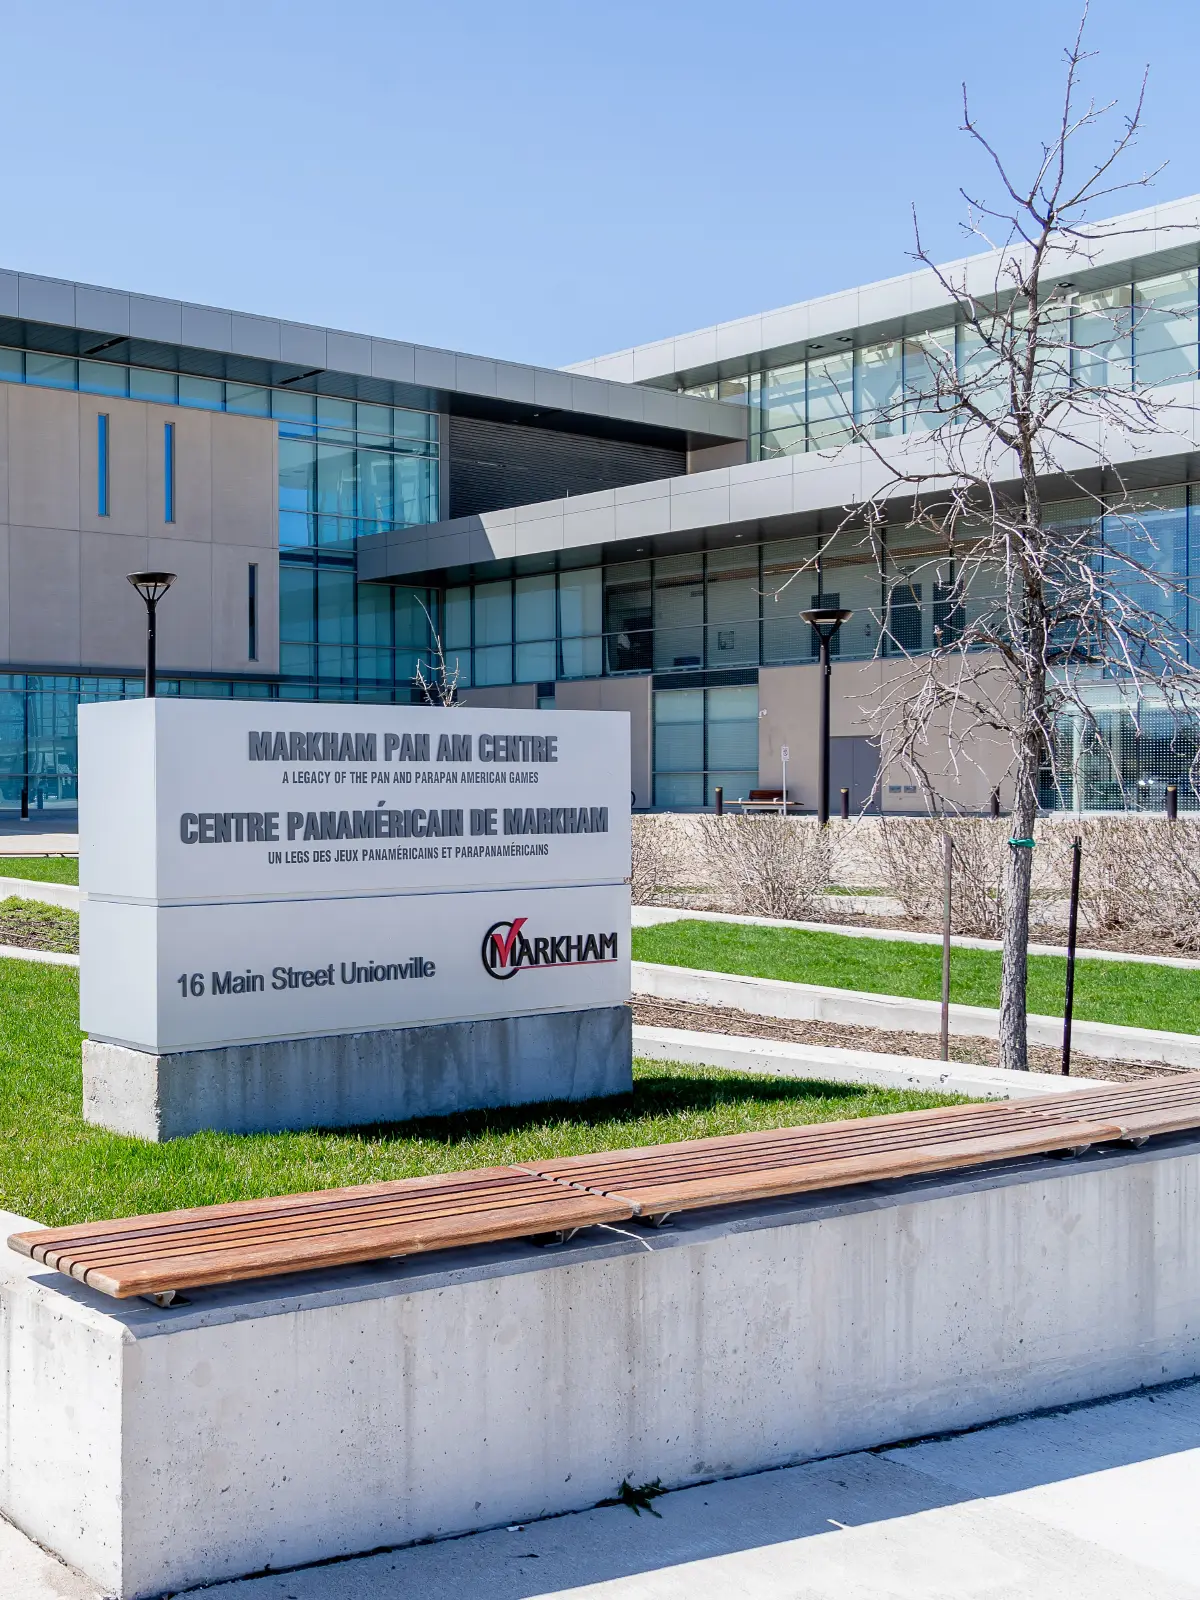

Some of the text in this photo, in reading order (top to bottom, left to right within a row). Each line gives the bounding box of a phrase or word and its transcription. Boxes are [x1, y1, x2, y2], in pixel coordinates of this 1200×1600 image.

[249, 731, 558, 762] MARKHAM PAN AM CENTRE
[282, 771, 539, 784] A LEGACY OF THE PAN AND PARAPAN AMERICAN GAMES
[180, 800, 608, 844] CENTRE PANAMÉRICAIN DE MARKHAM
[268, 842, 549, 864] UN LEGS DES JEUX PANAMÉRICAINS ET PARAPANAMÉRICAINS
[488, 918, 618, 970] MARKHAM
[177, 957, 436, 997] 16 Main Street Unionville
